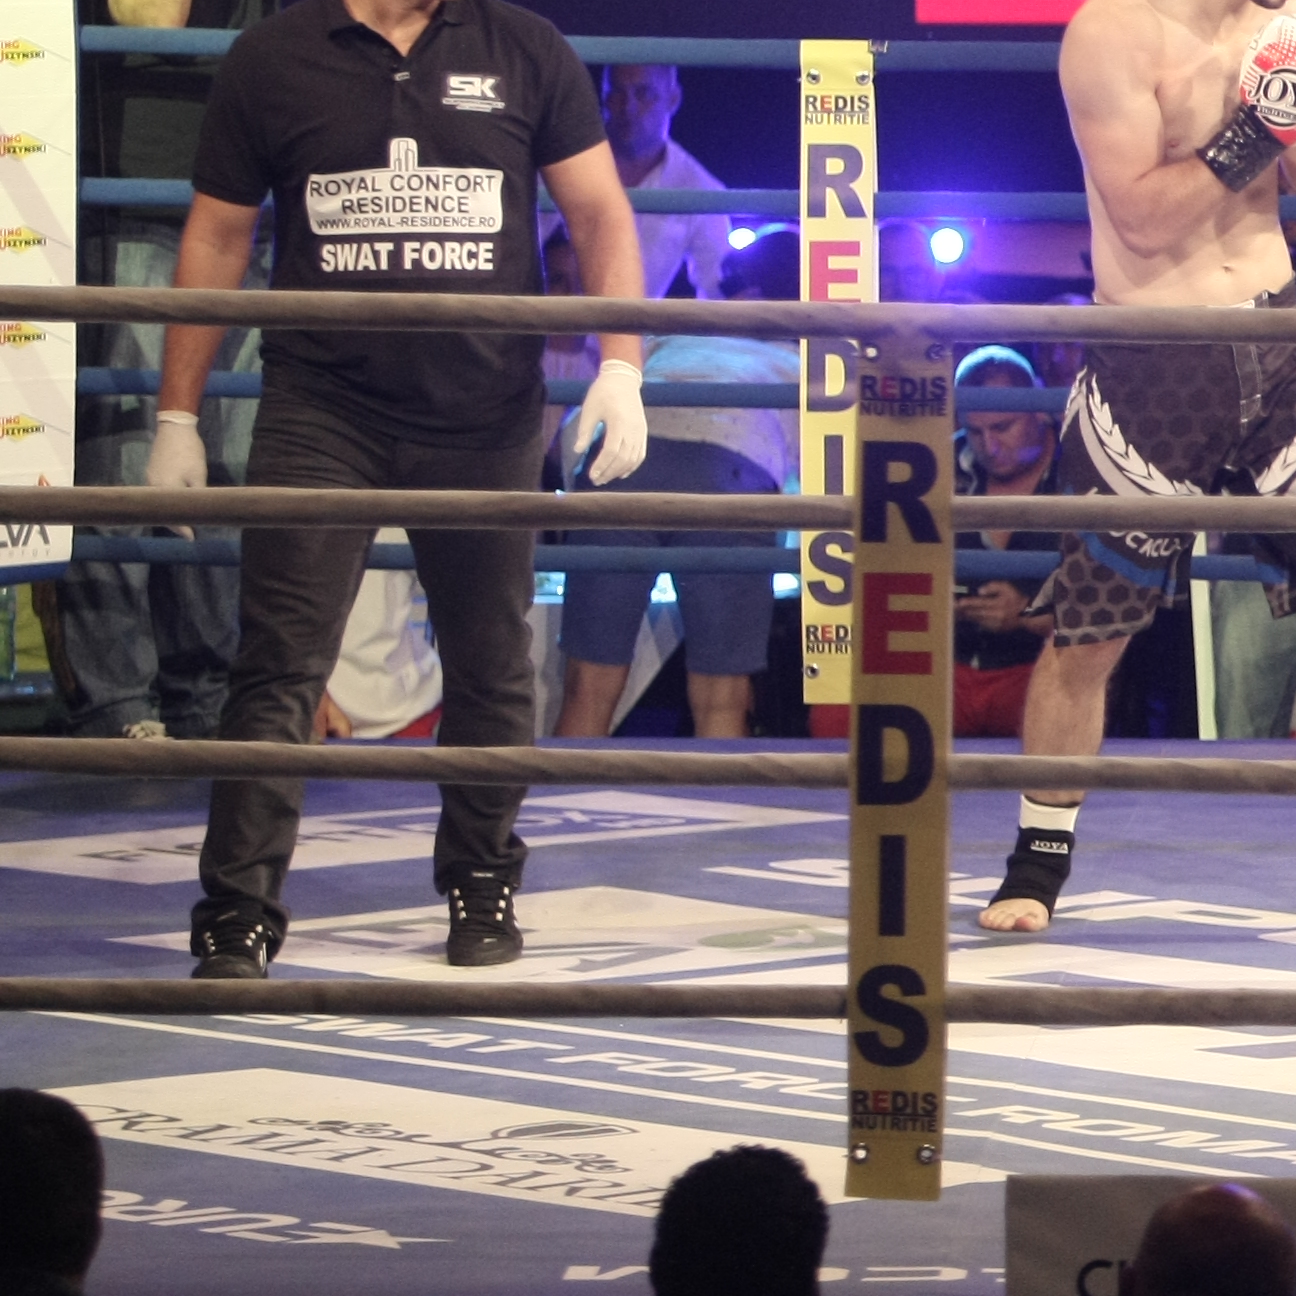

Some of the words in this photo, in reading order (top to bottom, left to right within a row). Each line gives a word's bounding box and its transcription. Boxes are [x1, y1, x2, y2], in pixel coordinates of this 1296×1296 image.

[804, 94, 870, 112] REDIS
[804, 112, 870, 125] NUTRITIE
[310, 177, 381, 197] ROYAL
[390, 174, 496, 193] CONFORT
[342, 196, 470, 215] RESIDENCE
[316, 216, 496, 229] WWW.ROYAL-RESIDENCE.RO
[321, 242, 394, 272] SWAT
[404, 241, 494, 270] FORCE
[860, 375, 947, 401] REDIS
[860, 401, 947, 416] NUTRITIE
[853, 440, 943, 1067] REDIS
[851, 1090, 938, 1114] REDIS
[851, 1115, 938, 1133] NUTRITIE
